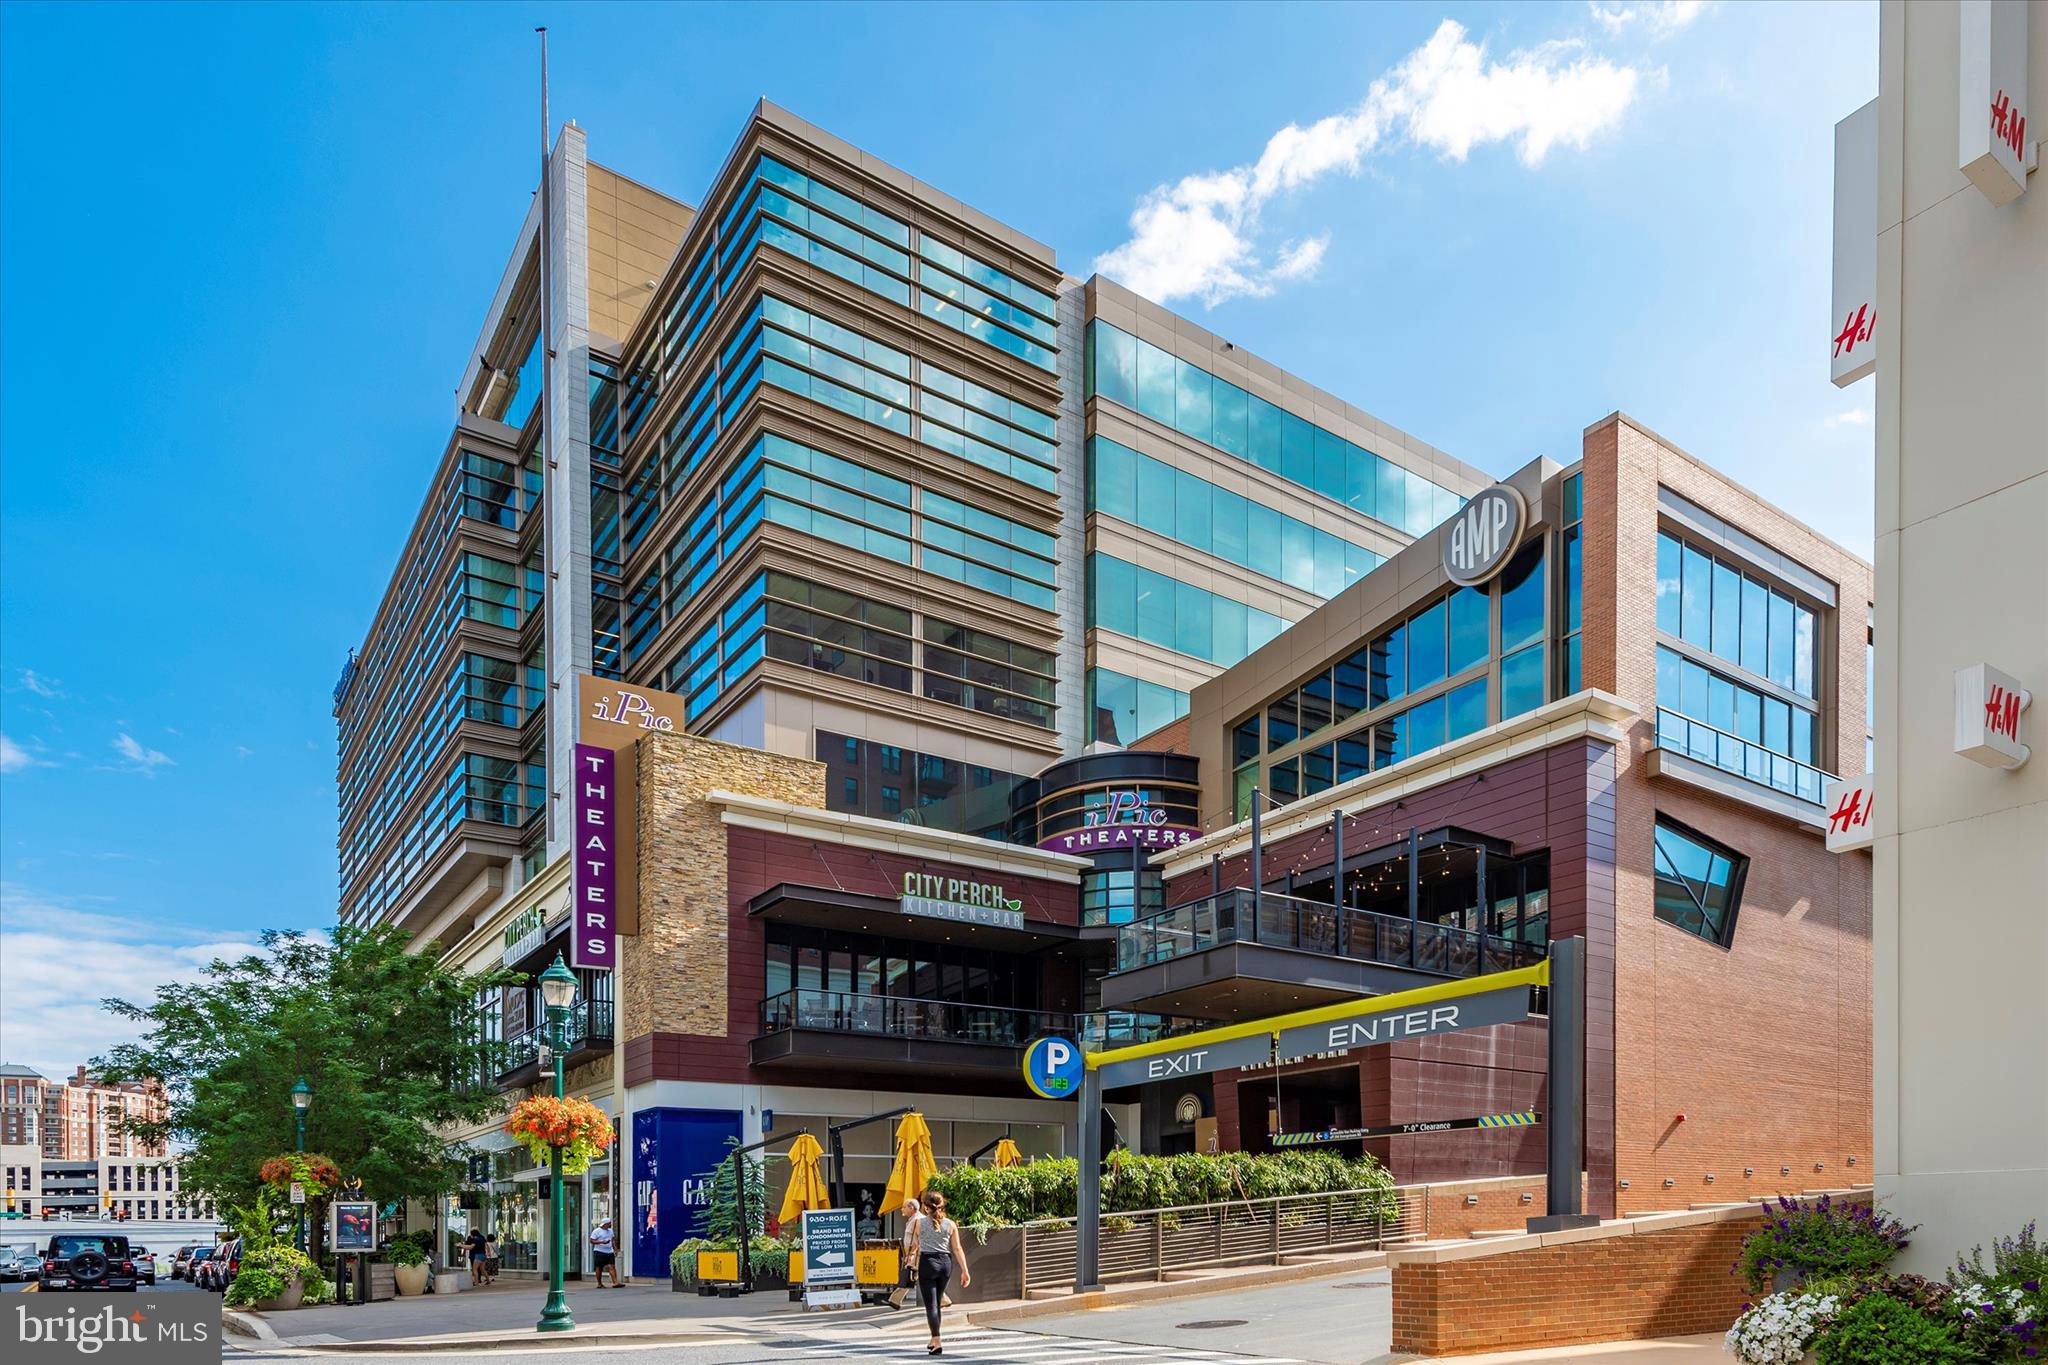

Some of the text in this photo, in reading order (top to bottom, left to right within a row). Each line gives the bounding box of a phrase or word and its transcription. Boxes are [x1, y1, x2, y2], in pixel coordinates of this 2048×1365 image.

[1991, 89, 2025, 162] H&M
[1834, 303, 1876, 358] H&
[1452, 497, 1508, 569] AMP
[592, 690, 674, 731] iPic
[1985, 684, 2020, 742] H&M
[1084, 791, 1168, 829] iPic
[586, 756, 606, 954] THEATERS
[1064, 829, 1190, 848] THEATERS
[904, 872, 1003, 908] CITY PERCH
[906, 898, 976, 921] KITCHEN
[993, 911, 1021, 927] BAR
[1328, 1005, 1459, 1047] ENTER
[1048, 1042, 1070, 1074] P
[1148, 1051, 1209, 1079] EXIT
[1420, 1122, 1451, 1132] Clearance
